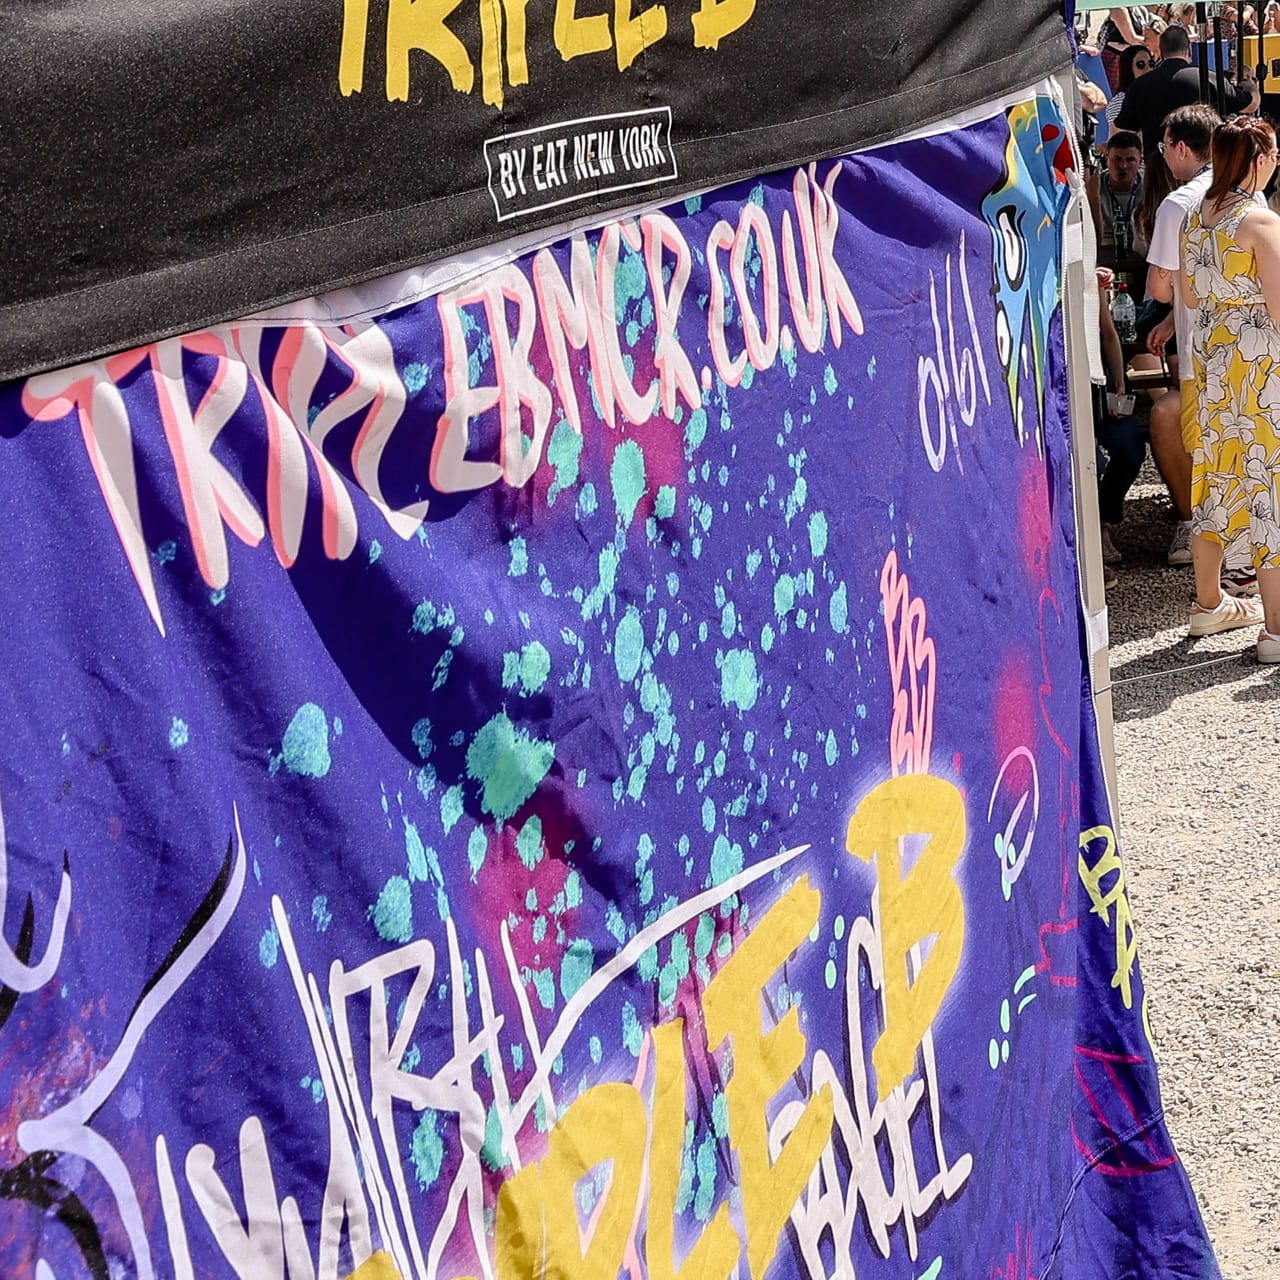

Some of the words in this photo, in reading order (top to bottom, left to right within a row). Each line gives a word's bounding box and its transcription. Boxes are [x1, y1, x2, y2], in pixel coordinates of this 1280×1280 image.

[498, 148, 527, 199] BY
[532, 138, 568, 191] EAT
[573, 130, 615, 180] NEW
[619, 122, 666, 171] YORK
